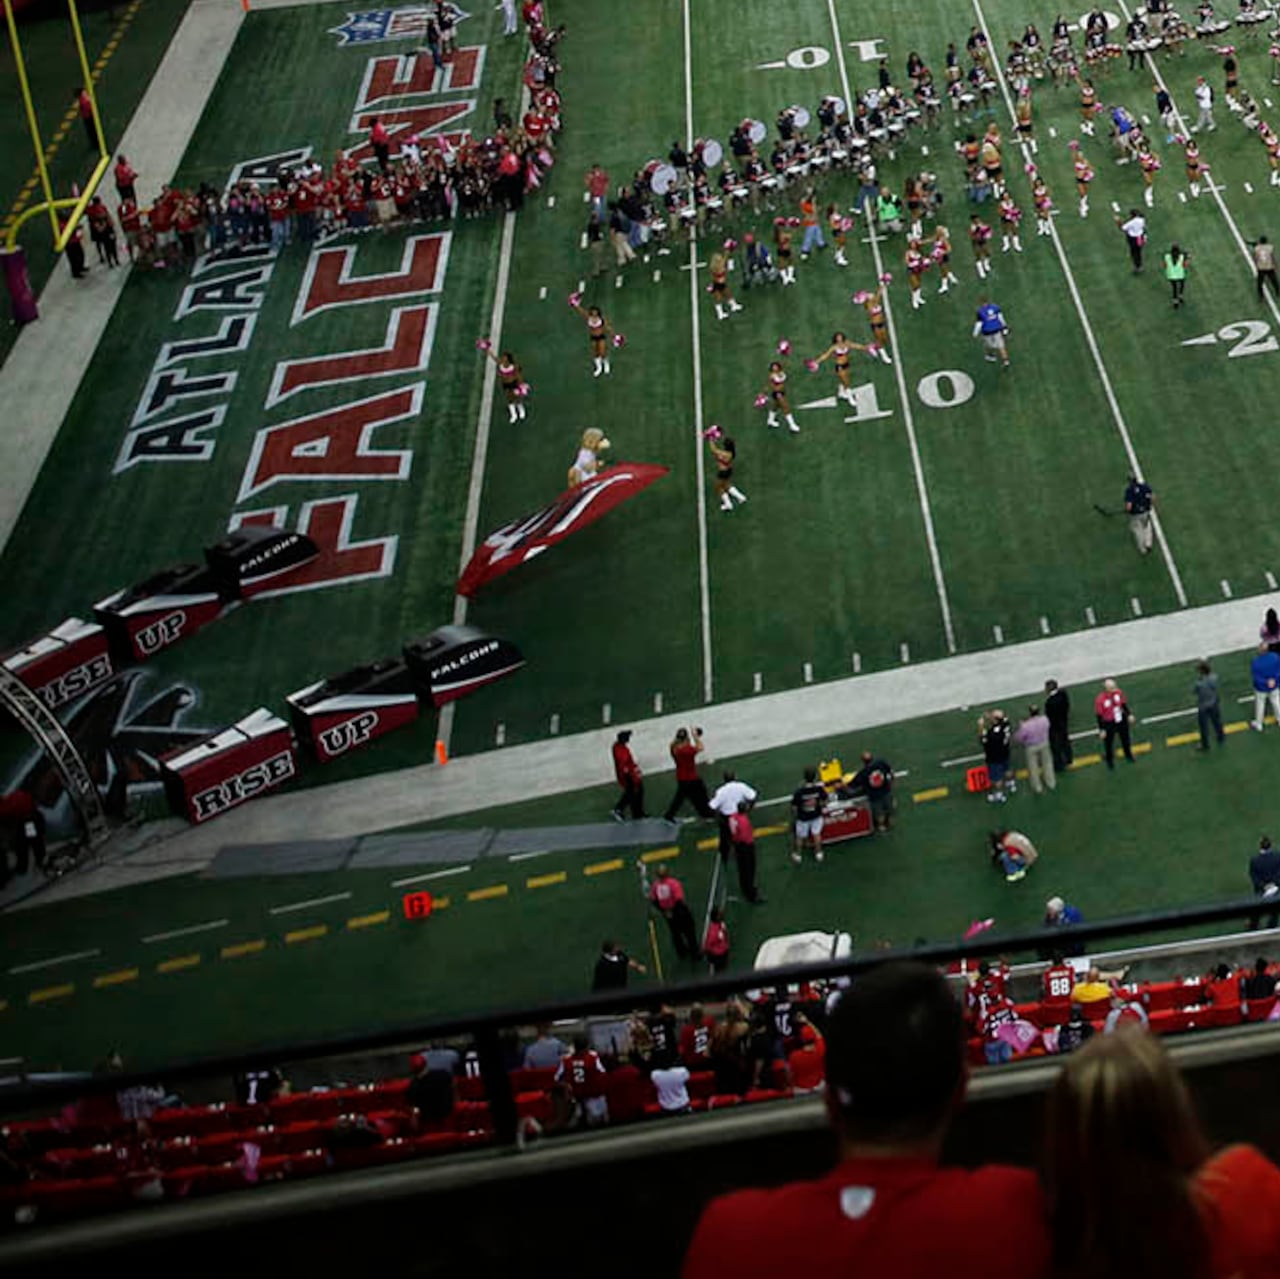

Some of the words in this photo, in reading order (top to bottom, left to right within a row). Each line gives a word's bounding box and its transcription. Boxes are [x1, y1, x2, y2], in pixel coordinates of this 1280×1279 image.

[227, 42, 488, 599] FALCNS
[840, 369, 976, 424] 10
[135, 608, 187, 656] UP
[319, 709, 380, 757] UP
[193, 751, 297, 819] RISE
[1050, 977, 1070, 997] 88
